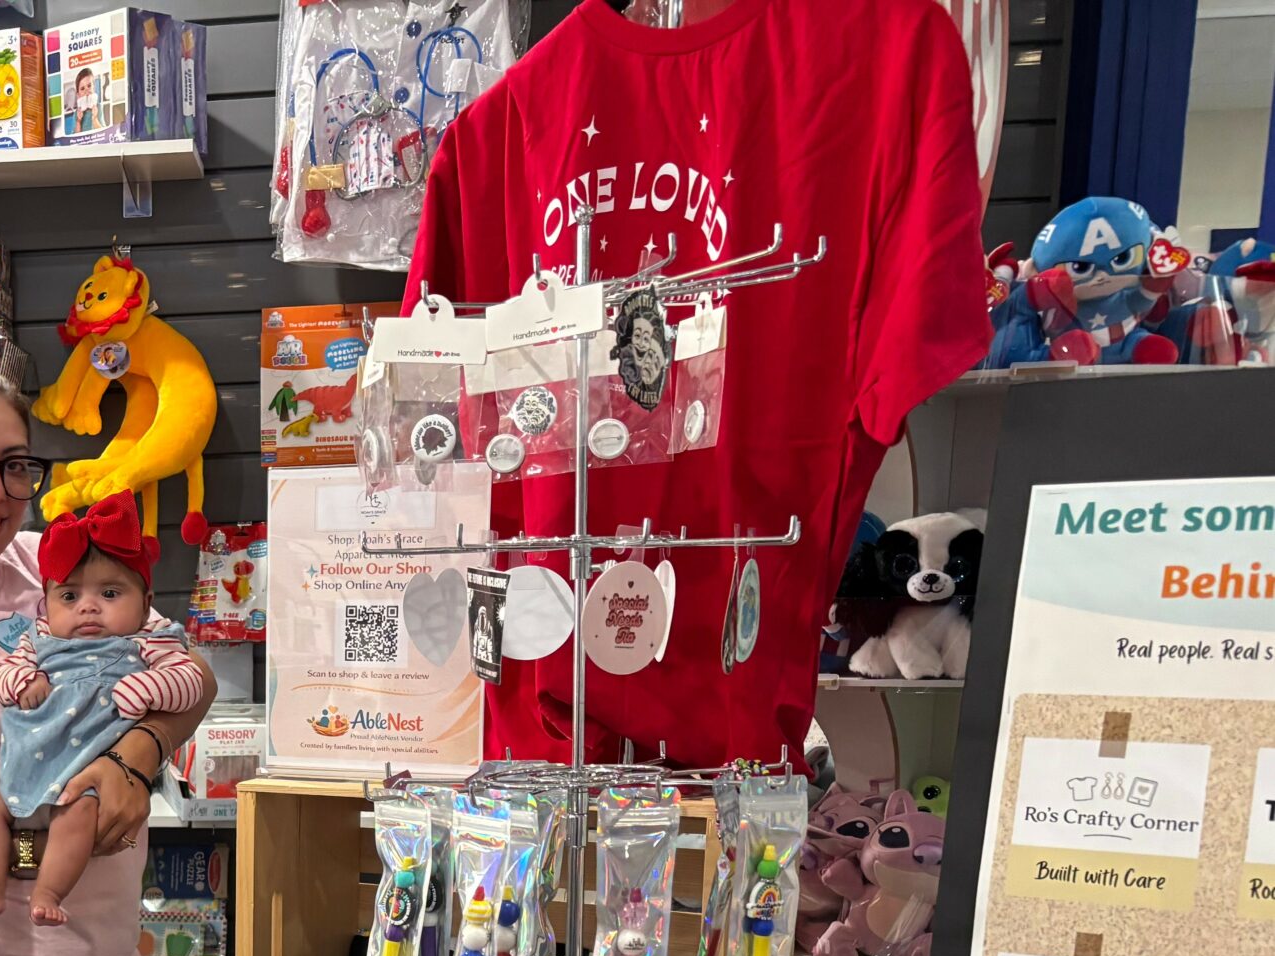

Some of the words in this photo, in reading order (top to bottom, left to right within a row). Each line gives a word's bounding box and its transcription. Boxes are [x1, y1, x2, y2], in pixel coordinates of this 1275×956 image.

[8, 35, 17, 45] 3+
[70, 27, 100, 40] Sensory
[68, 36, 102, 52] SQUARES
[70, 57, 78, 66] 20
[543, 166, 618, 246] ONE
[629, 162, 728, 261] LOVED
[1151, 245, 1177, 275] ty
[512, 327, 550, 340] Handmade
[397, 349, 433, 358] Handmade
[1055, 502, 1167, 535] Meet
[1181, 504, 1275, 532] som
[327, 535, 355, 545] Shop:
[394, 533, 423, 544] race
[320, 562, 363, 575] Follow
[366, 563, 393, 575] Our
[396, 562, 432, 576] Shop
[314, 580, 342, 592] Shop
[345, 579, 382, 590] Online
[608, 592, 649, 611] Special
[606, 610, 643, 628] Needs
[1117, 637, 1153, 660] Real
[1158, 640, 1214, 664] people.
[1221, 638, 1260, 661] Real
[307, 669, 326, 679] Scan
[339, 671, 359, 681] shop
[361, 670, 369, 679] &
[371, 671, 392, 680] leave
[402, 672, 430, 681] review
[350, 709, 424, 732] AbleNest
[208, 728, 256, 740] SENSORY
[326, 743, 332, 751] by
[333, 743, 357, 751] families
[359, 745, 375, 753] living
[391, 746, 413, 754] special
[414, 746, 438, 754] abilities
[1025, 806, 1059, 824] Ro's
[1064, 809, 1125, 830] Crafty
[1130, 813, 1200, 833] Corner
[186, 858, 194, 886] PUZZLE
[194, 851, 205, 881] GEAR
[1084, 867, 1118, 888] with
[1124, 868, 1166, 890] Care
